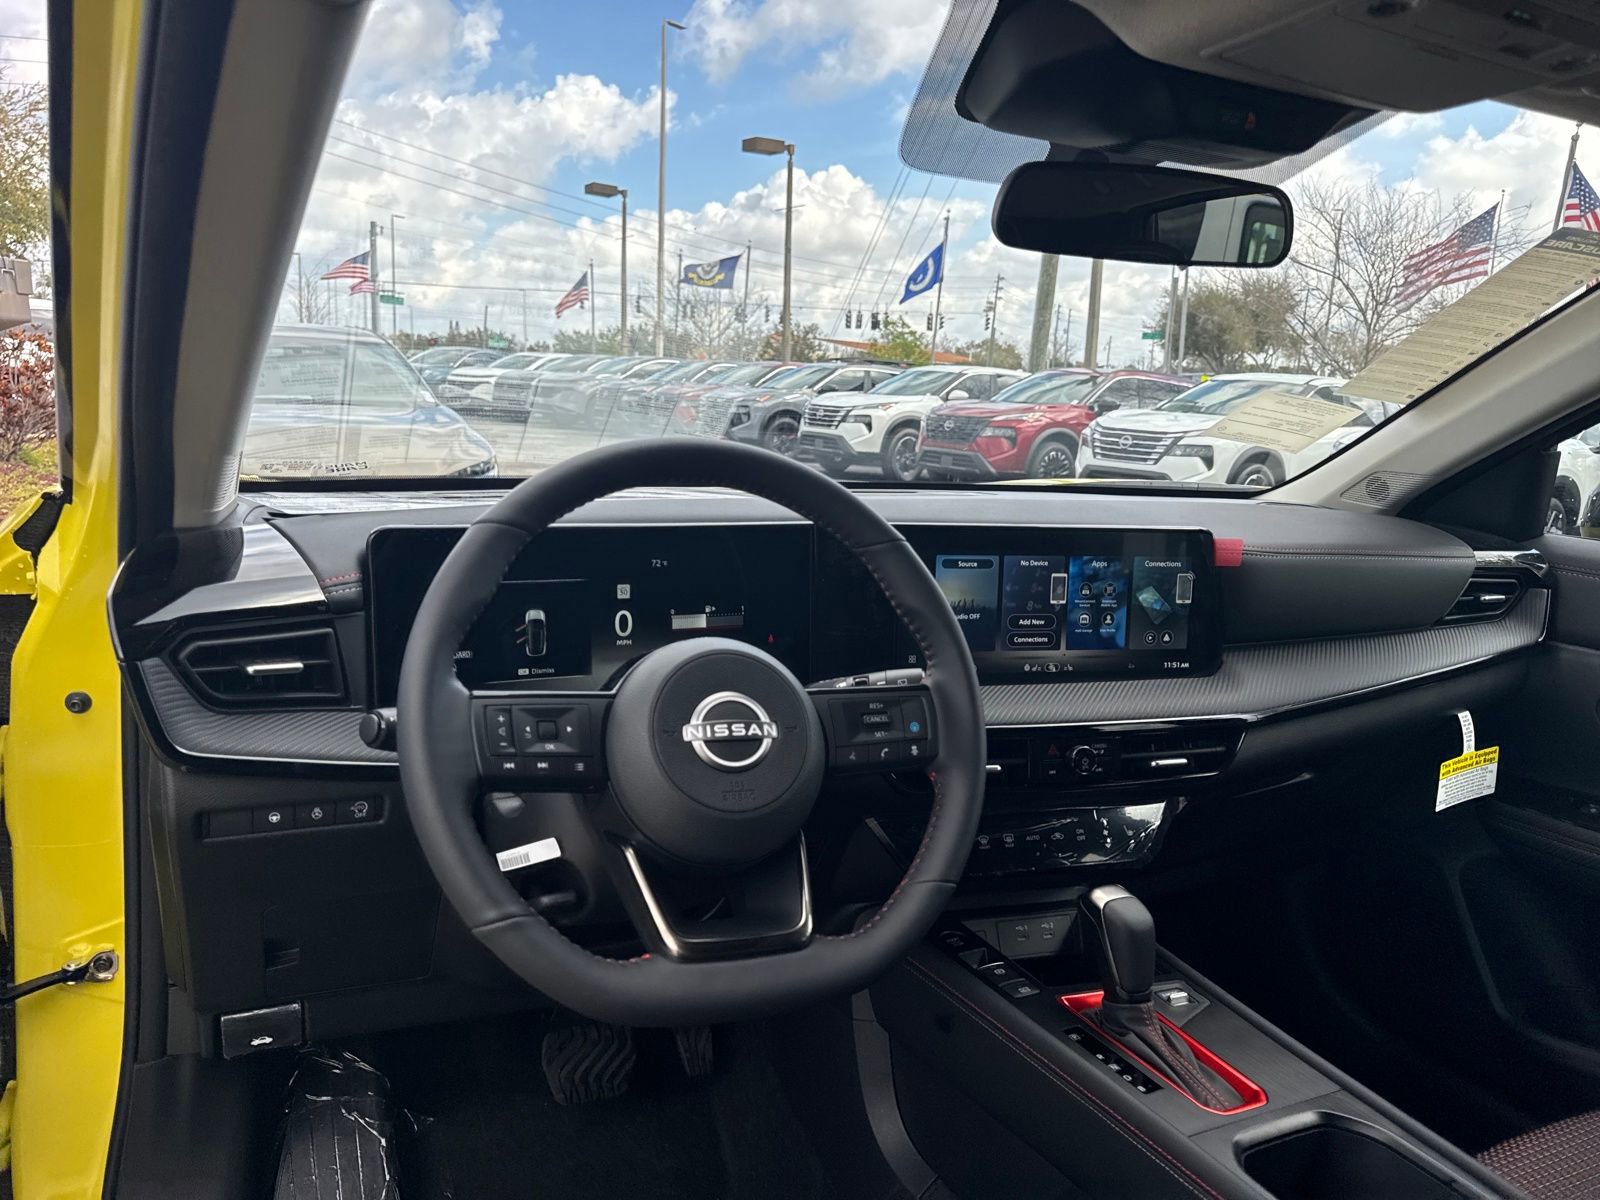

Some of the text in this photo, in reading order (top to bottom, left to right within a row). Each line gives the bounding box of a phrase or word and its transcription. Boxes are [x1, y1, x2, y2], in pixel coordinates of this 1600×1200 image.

[1091, 560, 1108, 568] Apps
[1144, 560, 1182, 568] Connections
[614, 609, 633, 637] 0
[685, 723, 778, 738] NISSAN
[1452, 757, 1468, 766] Vehicle
[1475, 748, 1498, 759] Equipped
[1452, 762, 1474, 773] Advanced
